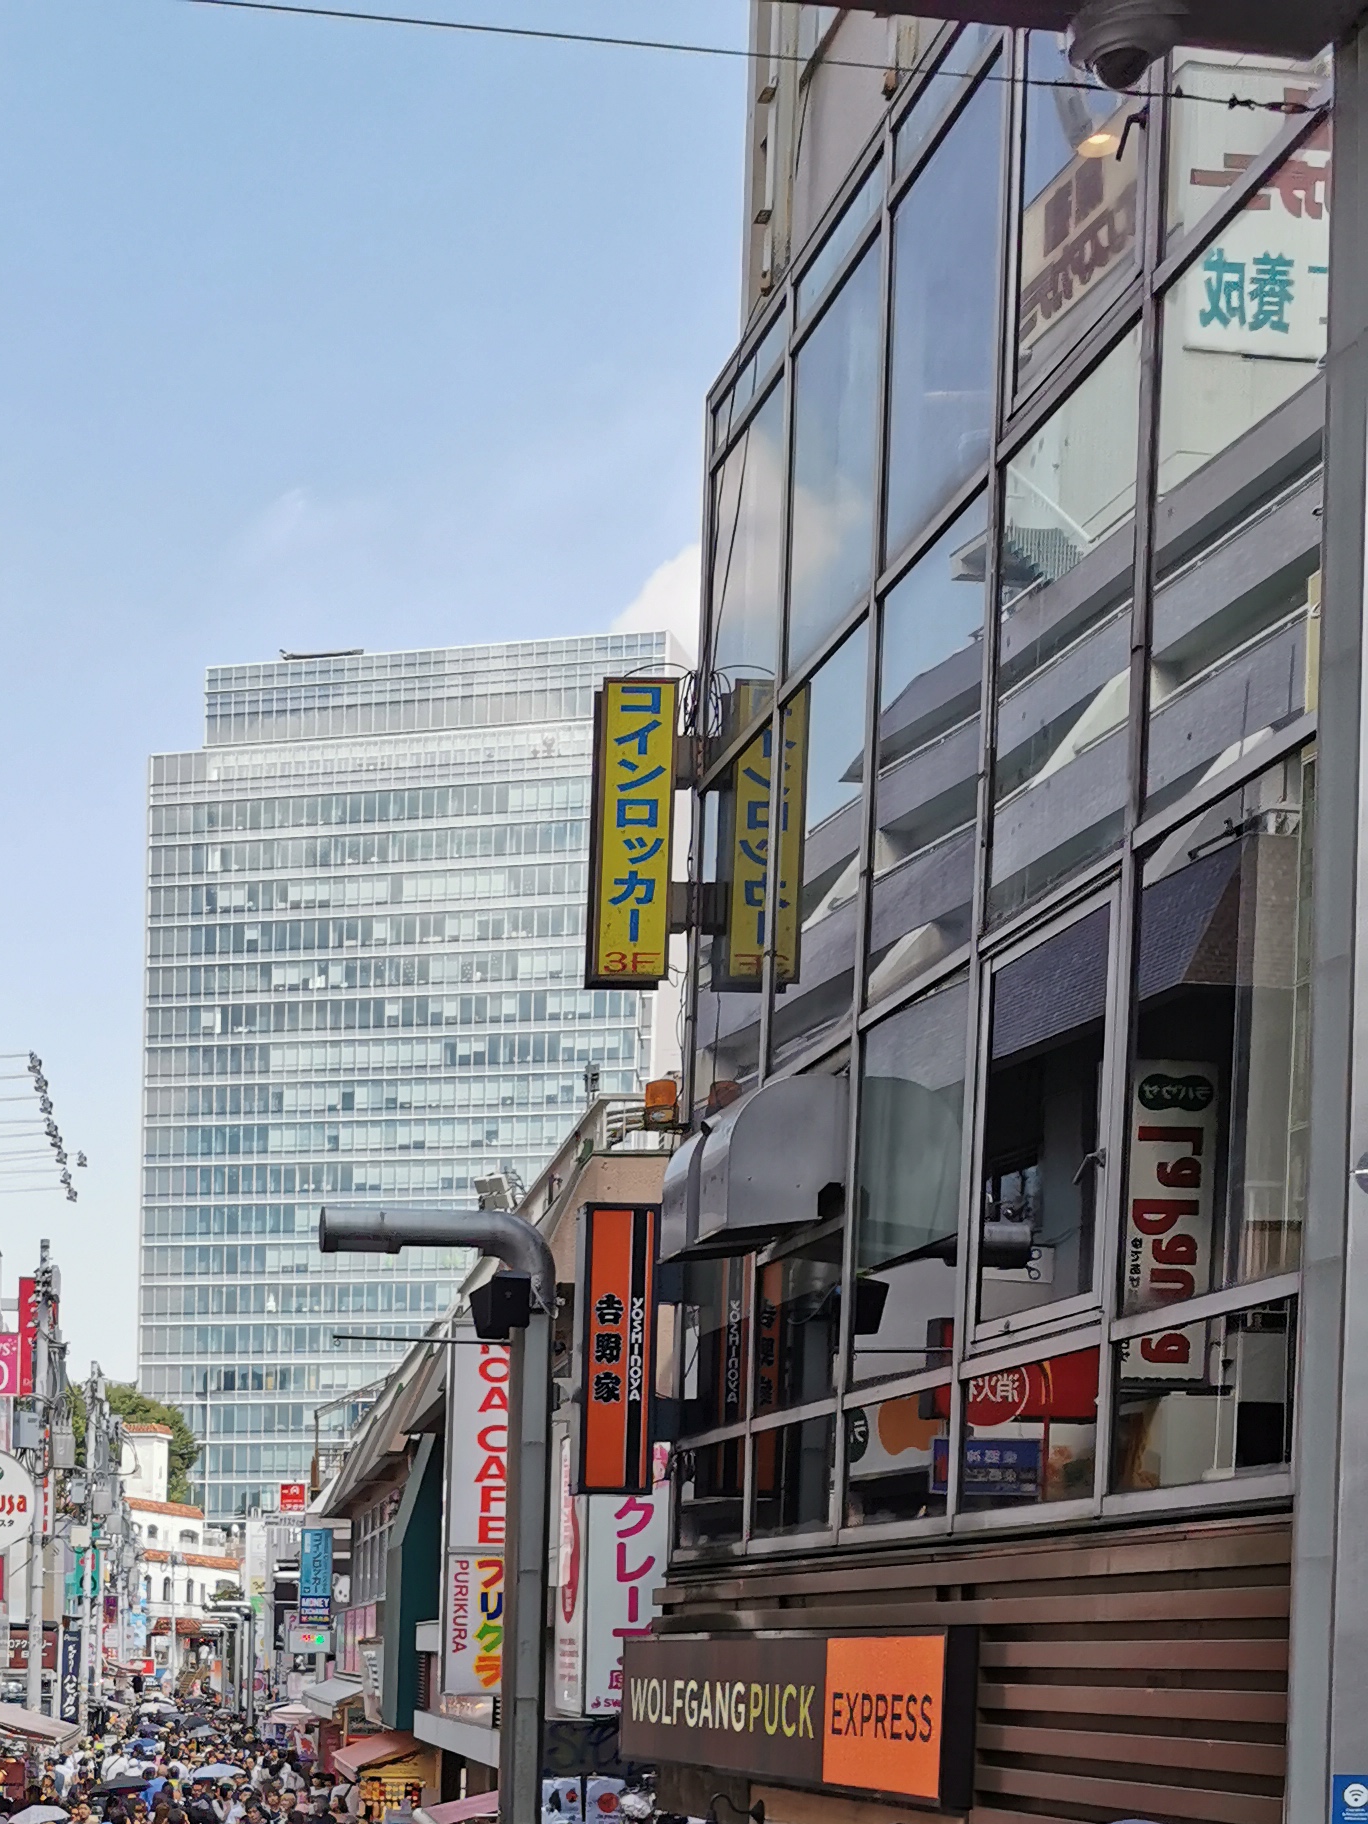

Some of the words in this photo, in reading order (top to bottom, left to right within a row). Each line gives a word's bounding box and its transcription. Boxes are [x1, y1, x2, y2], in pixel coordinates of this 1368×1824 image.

[608, 686, 667, 943] コインロッカー
[604, 952, 661, 973] 3F
[474, 1425, 509, 1545] CAFE
[453, 1560, 470, 1654] PURIKURA
[630, 1675, 746, 1733] WOLFGANG
[747, 1683, 815, 1739] PUCK
[830, 1690, 933, 1744] EXPRESS
